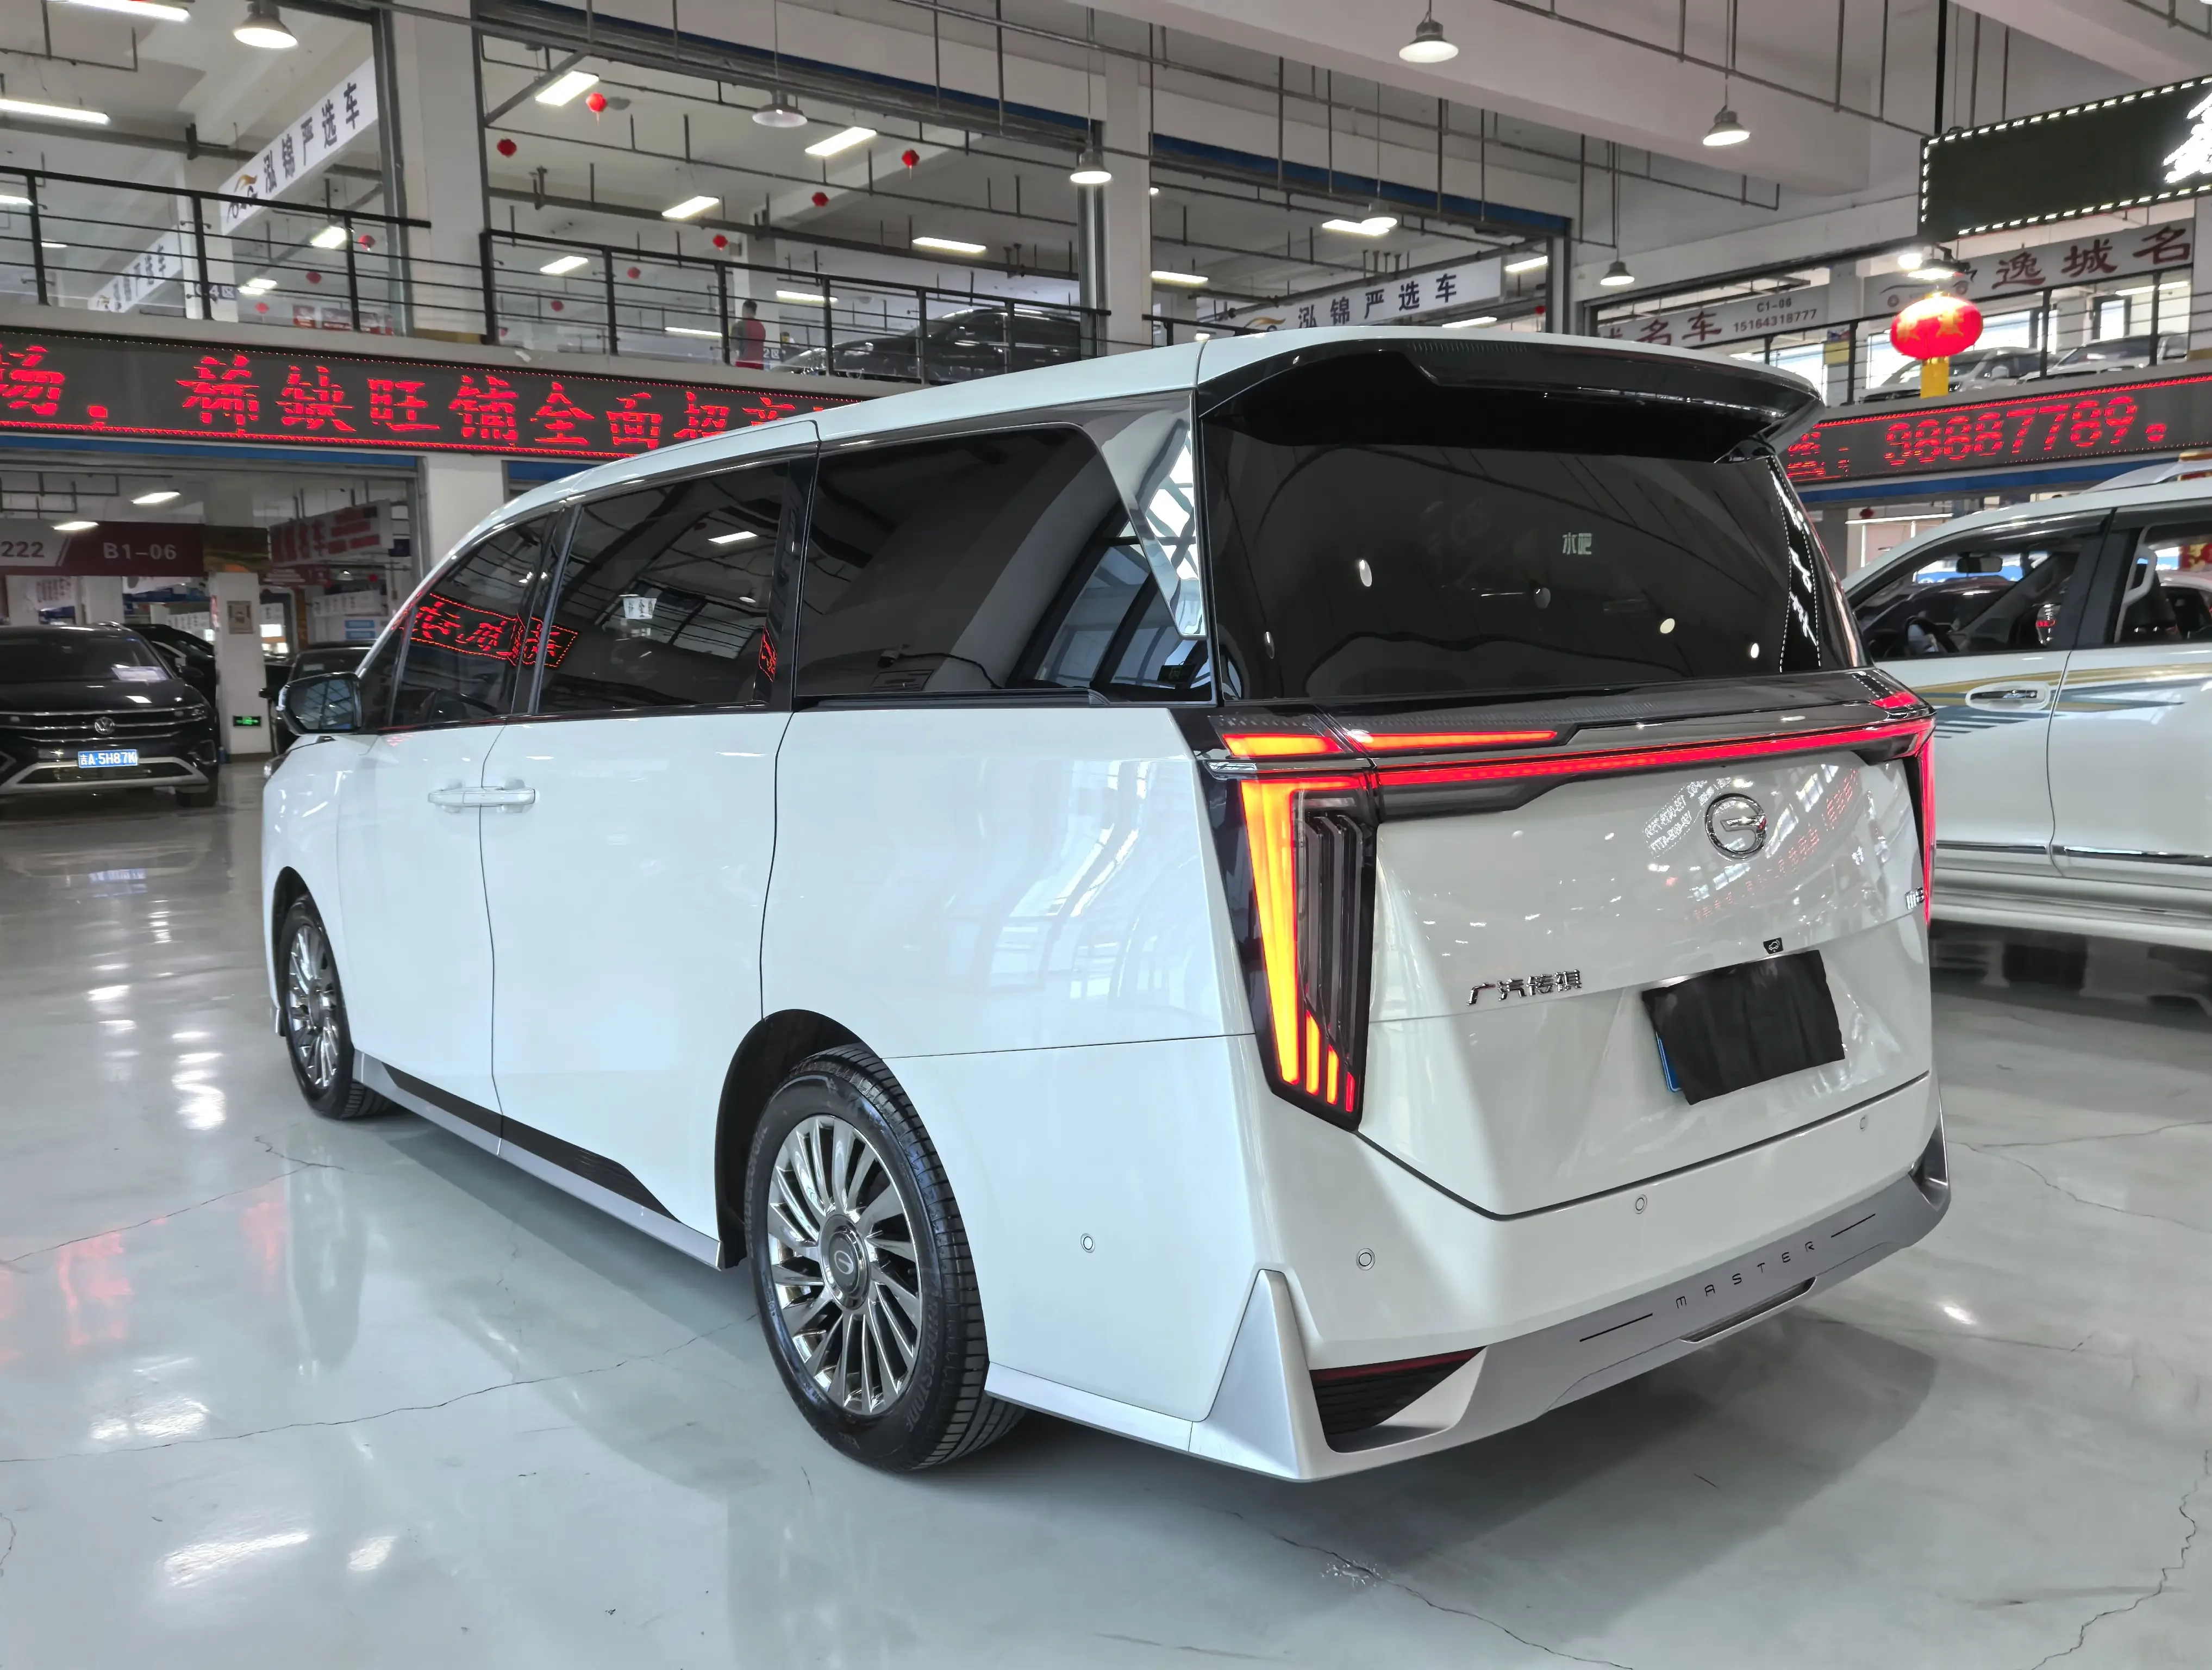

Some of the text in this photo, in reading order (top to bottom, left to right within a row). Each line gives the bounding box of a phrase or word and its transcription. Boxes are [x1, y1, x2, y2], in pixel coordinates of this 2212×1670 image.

[1298, 273, 1457, 328] 泓锦严选车
[1757, 297, 1792, 313] C1-06
[1733, 309, 1817, 332] 15164318777
[103, 542, 177, 560] B1-06
[1676, 1241, 1814, 1308] MASTER
